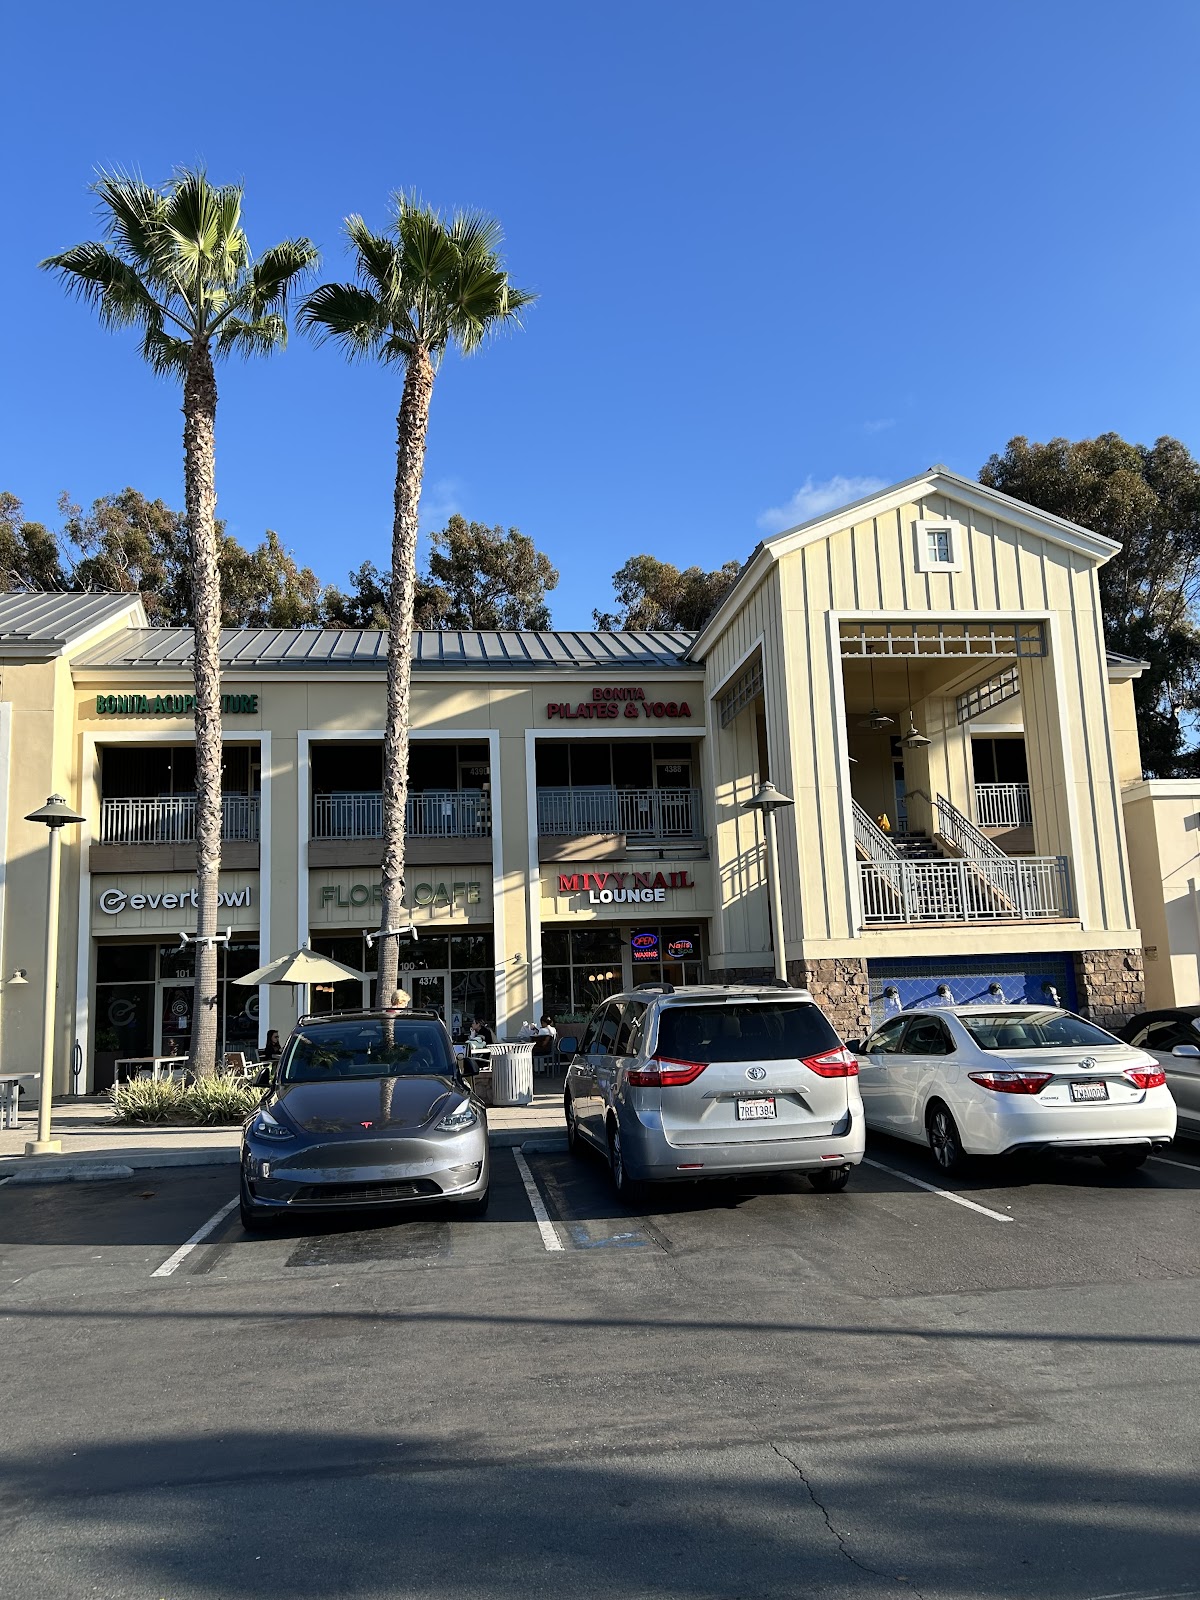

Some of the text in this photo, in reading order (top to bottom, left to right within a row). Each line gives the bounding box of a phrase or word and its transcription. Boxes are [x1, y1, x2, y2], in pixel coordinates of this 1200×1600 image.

[592, 688, 646, 701] BONITA
[96, 694, 259, 714] BONITA ACUPTURE
[547, 702, 691, 719] PILATES & YOGA
[558, 871, 695, 892] MIVY NAIL
[321, 882, 481, 908] FLOR CAFE
[589, 888, 666, 904] LOUNGE
[634, 936, 655, 946] OPEN
[400, 962, 415, 970] 100
[176, 970, 190, 978] 101
[419, 977, 438, 986] 4374
